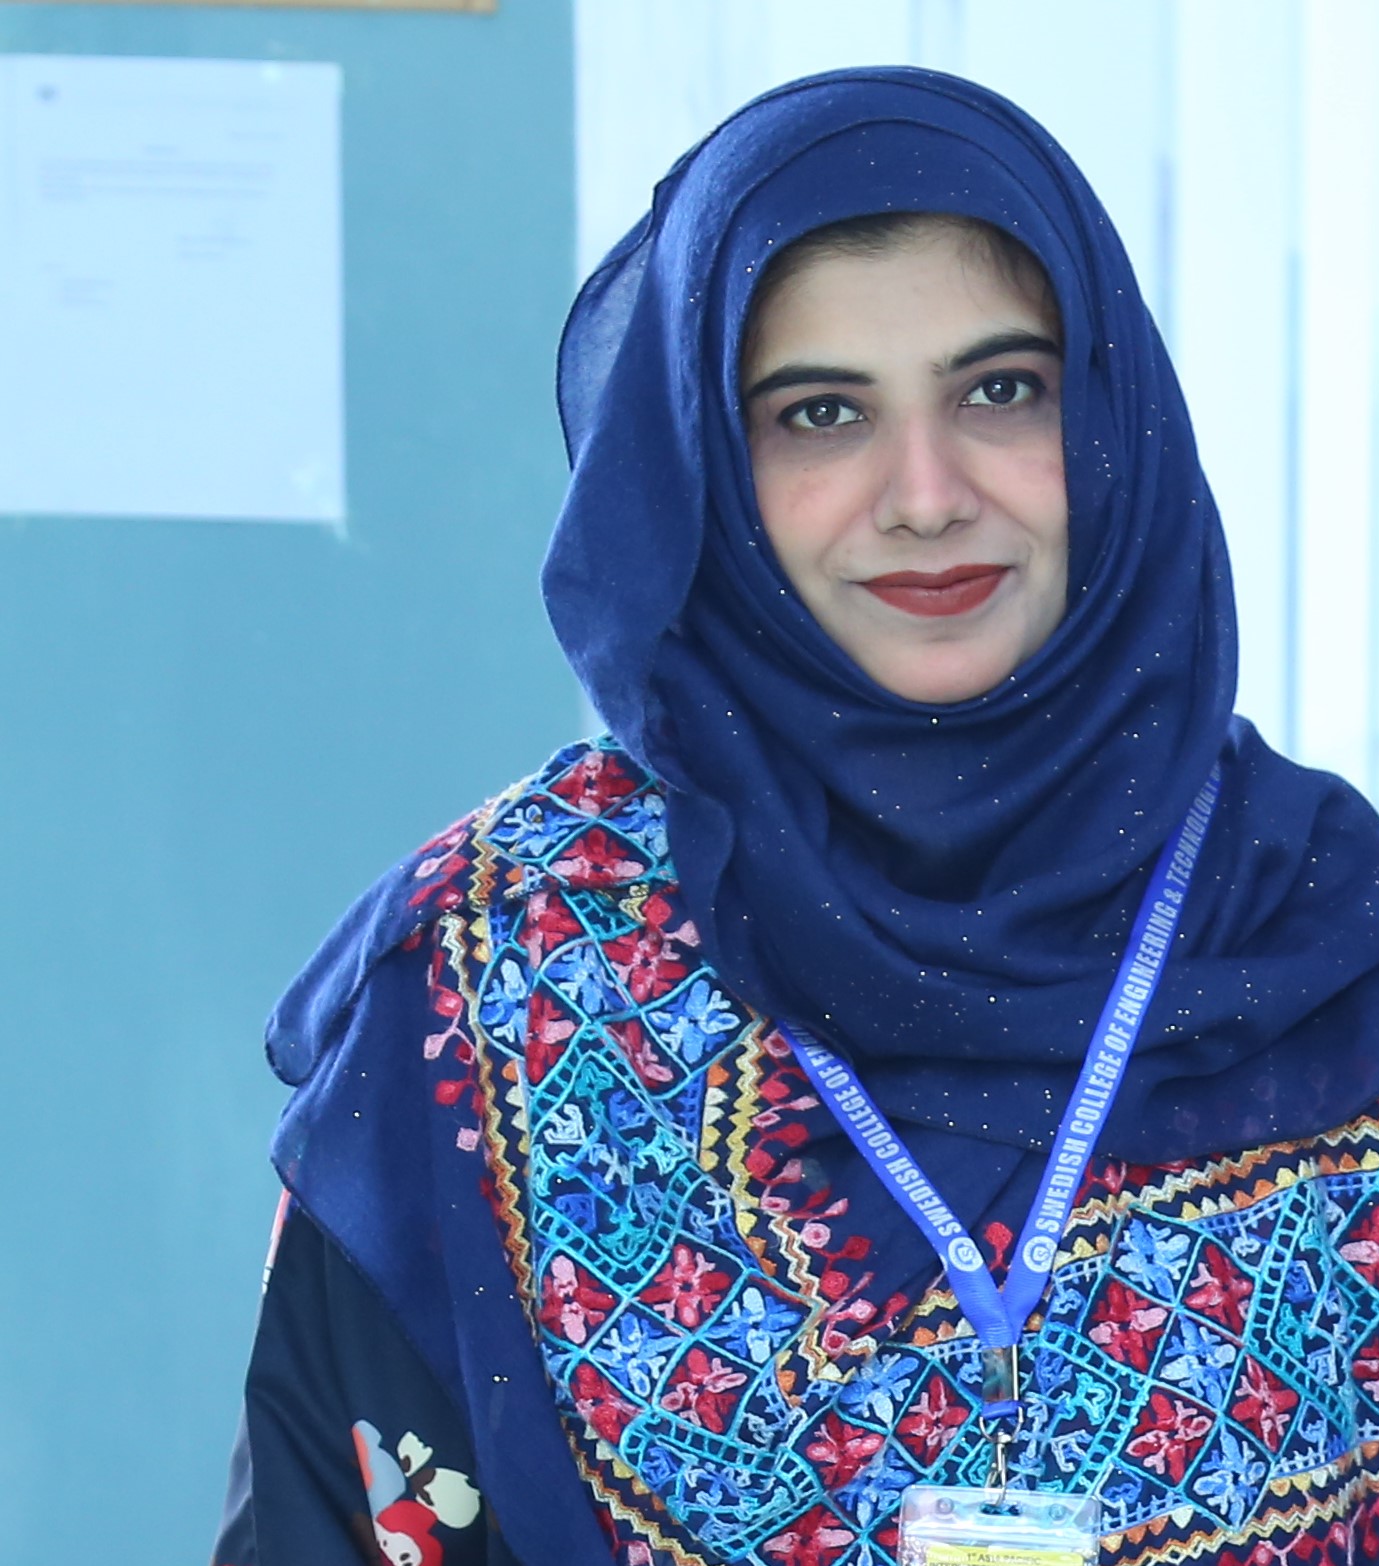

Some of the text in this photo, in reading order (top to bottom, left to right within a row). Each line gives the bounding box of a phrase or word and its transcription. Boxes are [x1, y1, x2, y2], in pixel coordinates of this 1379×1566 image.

[817, 1064, 962, 1238] SWEDISH COLLEGE OF
[1035, 780, 1219, 1233] SWEDISH COLLEGE OF ENGINEERING & TECHNOLOGY
